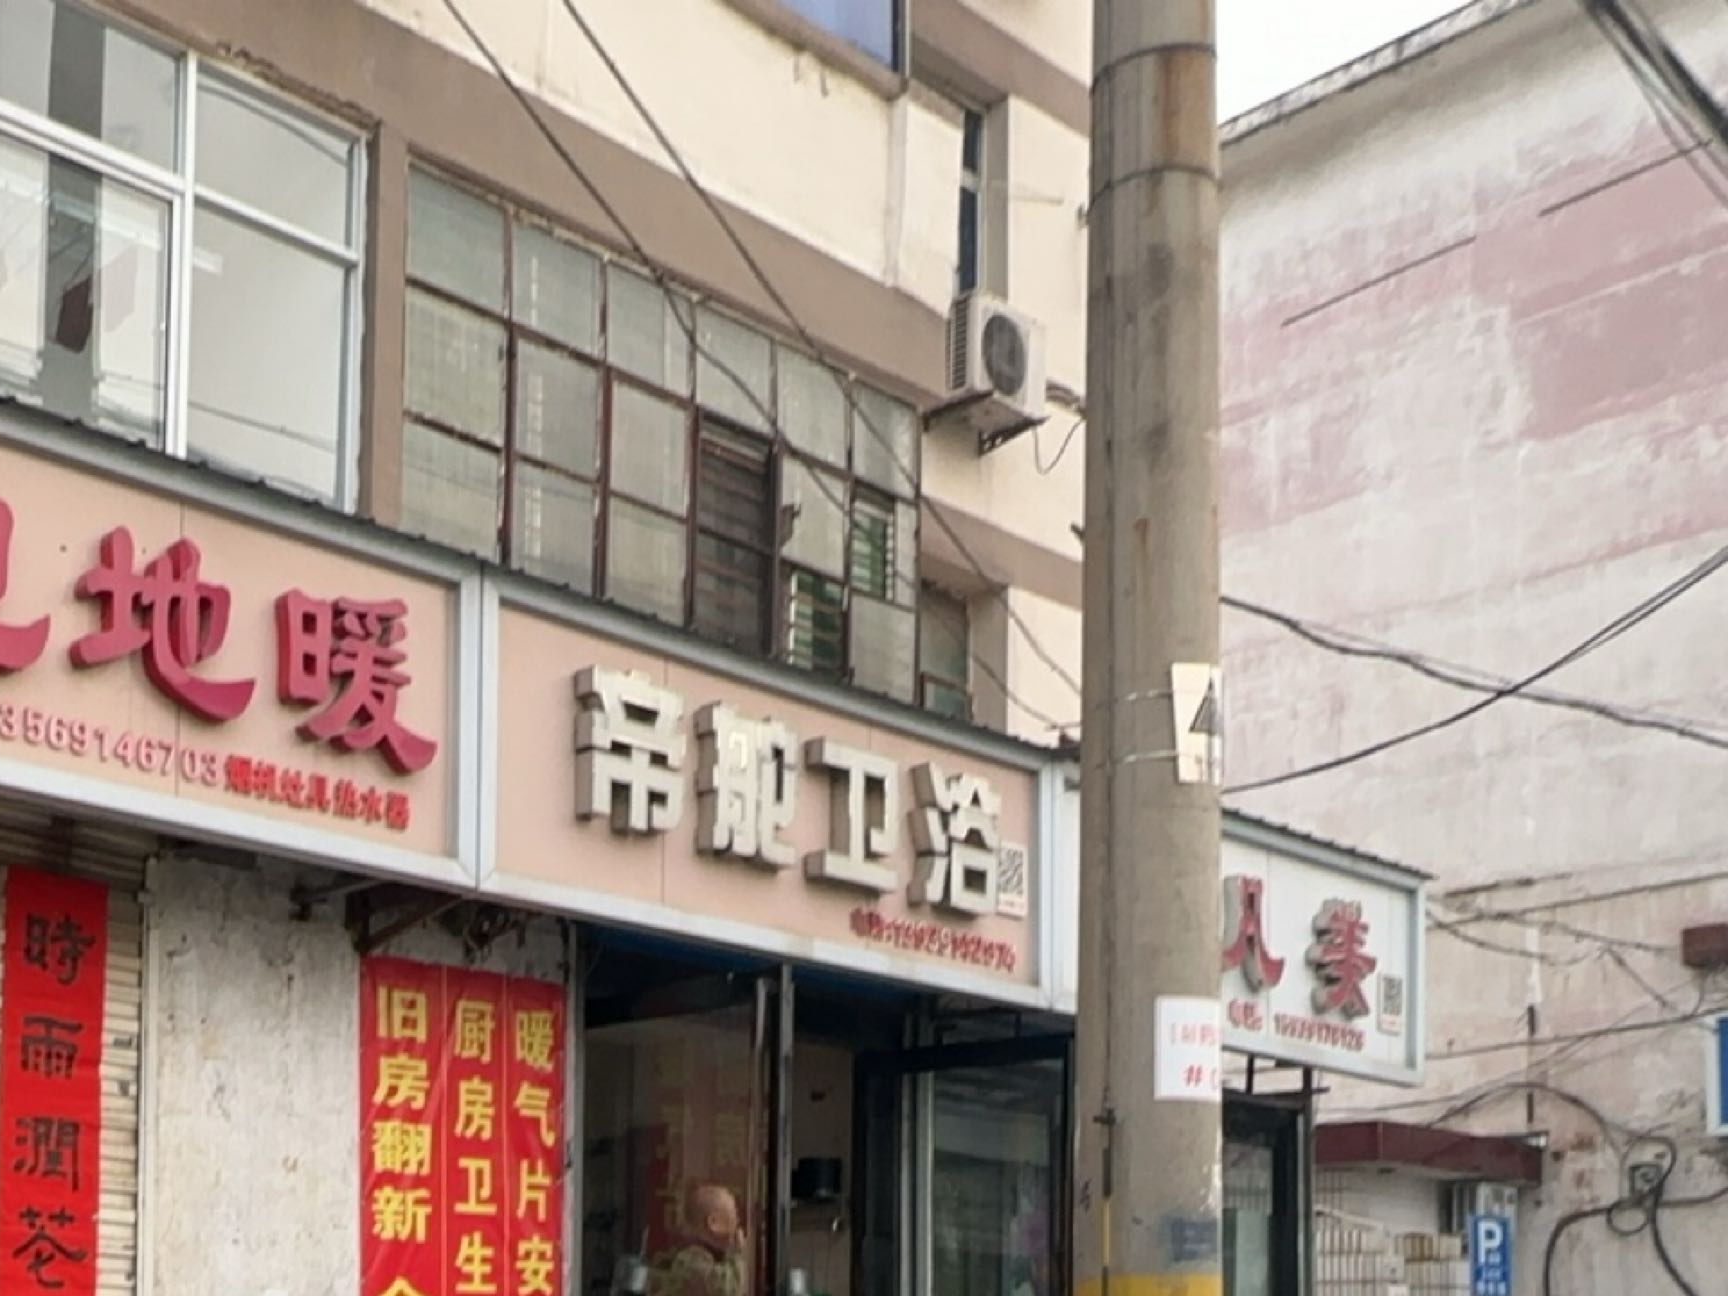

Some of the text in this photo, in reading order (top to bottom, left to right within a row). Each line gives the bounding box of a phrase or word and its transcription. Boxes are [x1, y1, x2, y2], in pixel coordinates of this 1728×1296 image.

[371, 984, 432, 1243] 旧房翻新
[1477, 1220, 1504, 1264] P
